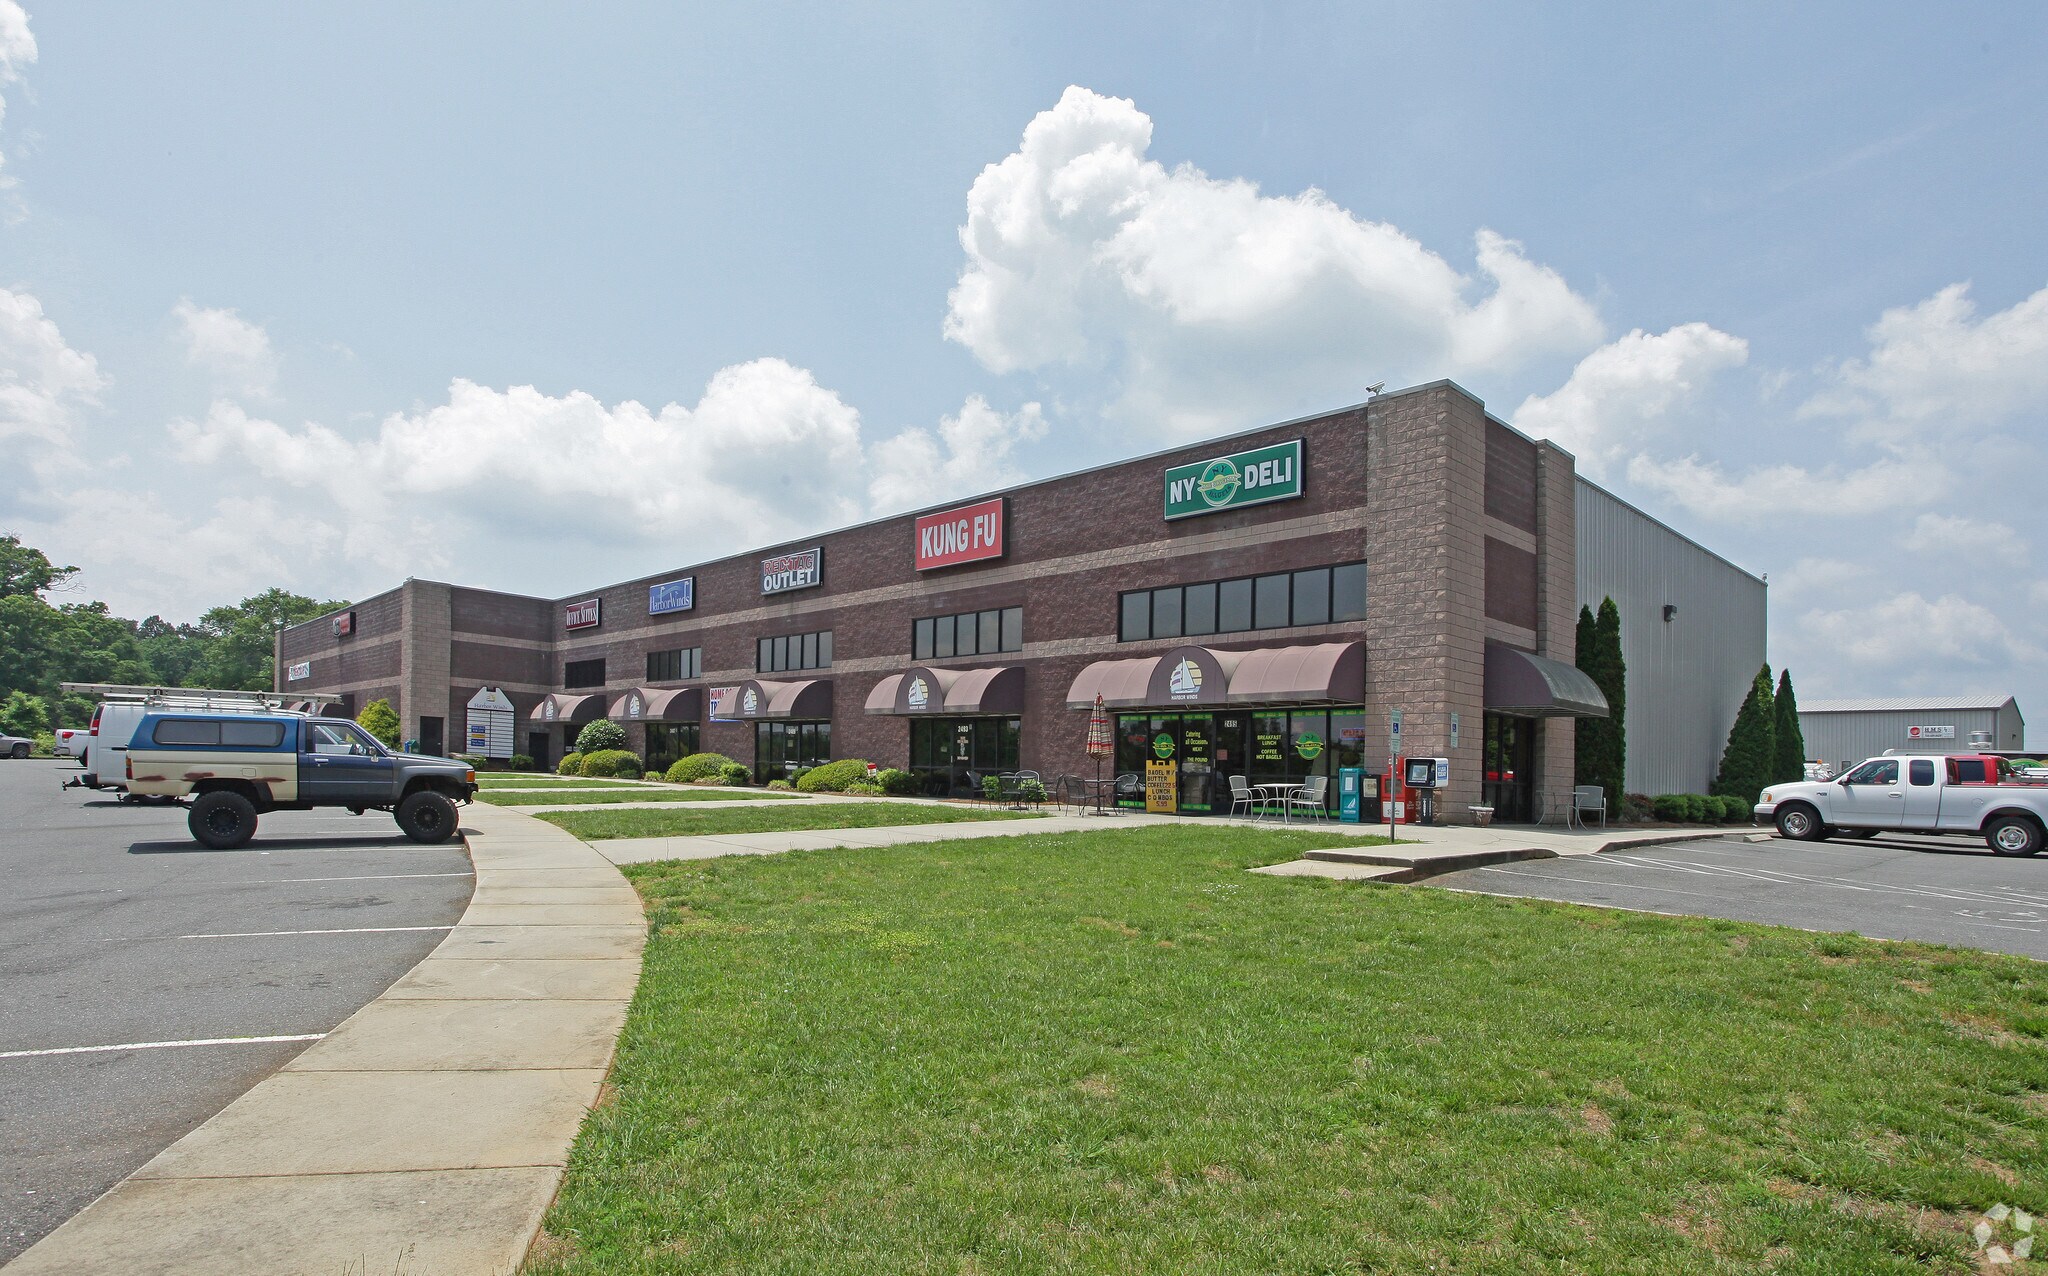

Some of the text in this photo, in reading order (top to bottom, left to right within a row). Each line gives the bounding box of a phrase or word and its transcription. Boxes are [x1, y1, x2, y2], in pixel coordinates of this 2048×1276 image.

[1170, 476, 1196, 504] NY
[1244, 457, 1292, 490] DELI
[921, 513, 996, 559] KUNG FU
[764, 554, 815, 576] RED TAG
[764, 569, 814, 591] OUTLET
